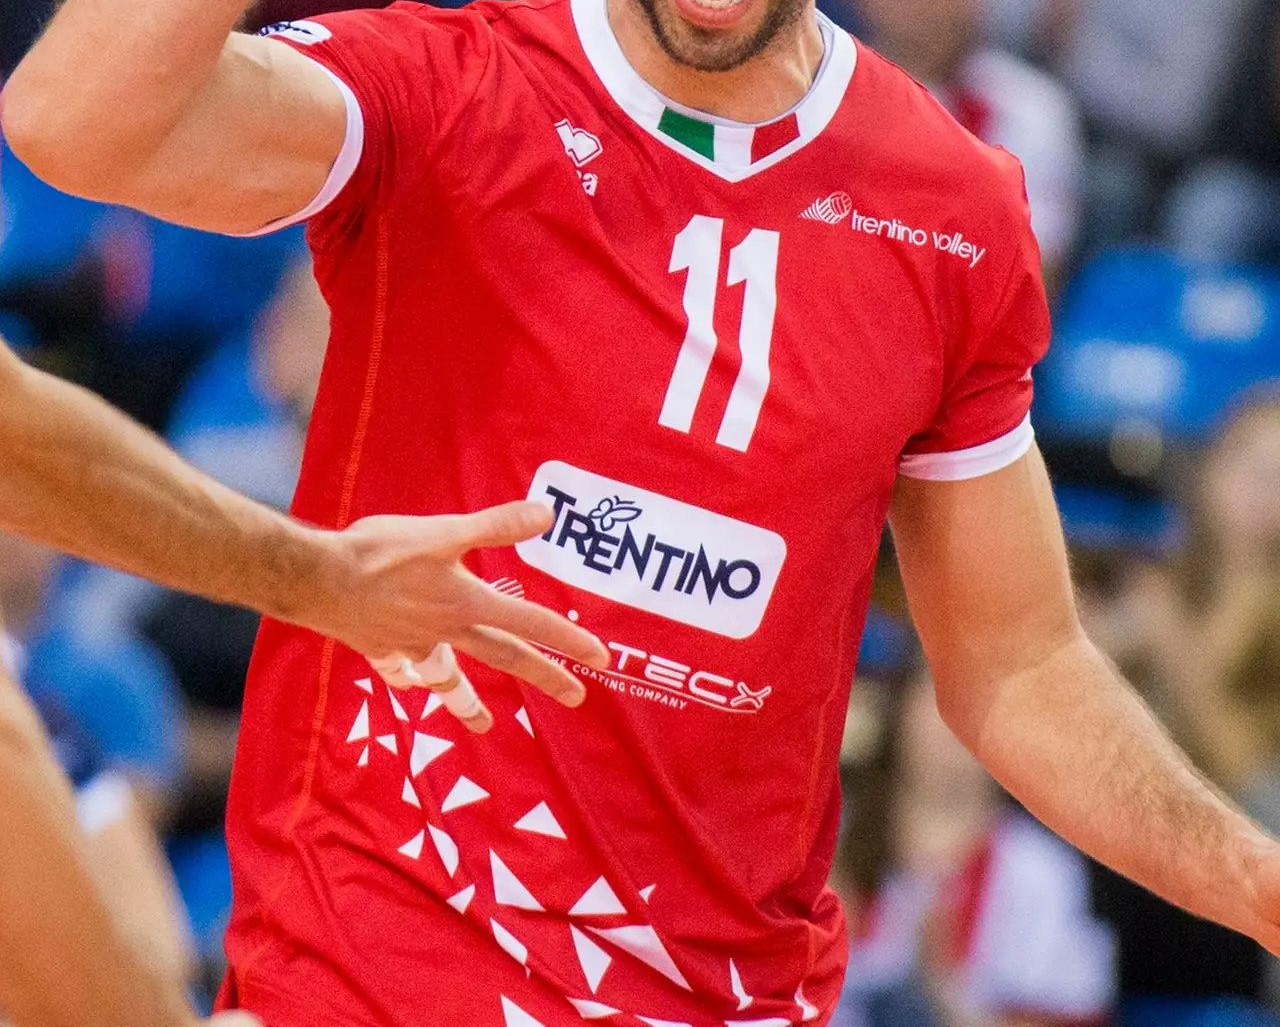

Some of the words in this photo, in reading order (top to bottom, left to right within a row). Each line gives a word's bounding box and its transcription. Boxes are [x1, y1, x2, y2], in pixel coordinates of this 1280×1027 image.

[851, 209, 928, 247] trentino
[932, 231, 987, 269] volley
[657, 214, 781, 453] 11
[541, 485, 762, 606] TRENTINO
[572, 663, 626, 693] COATING
[629, 685, 688, 710] COMPANY
